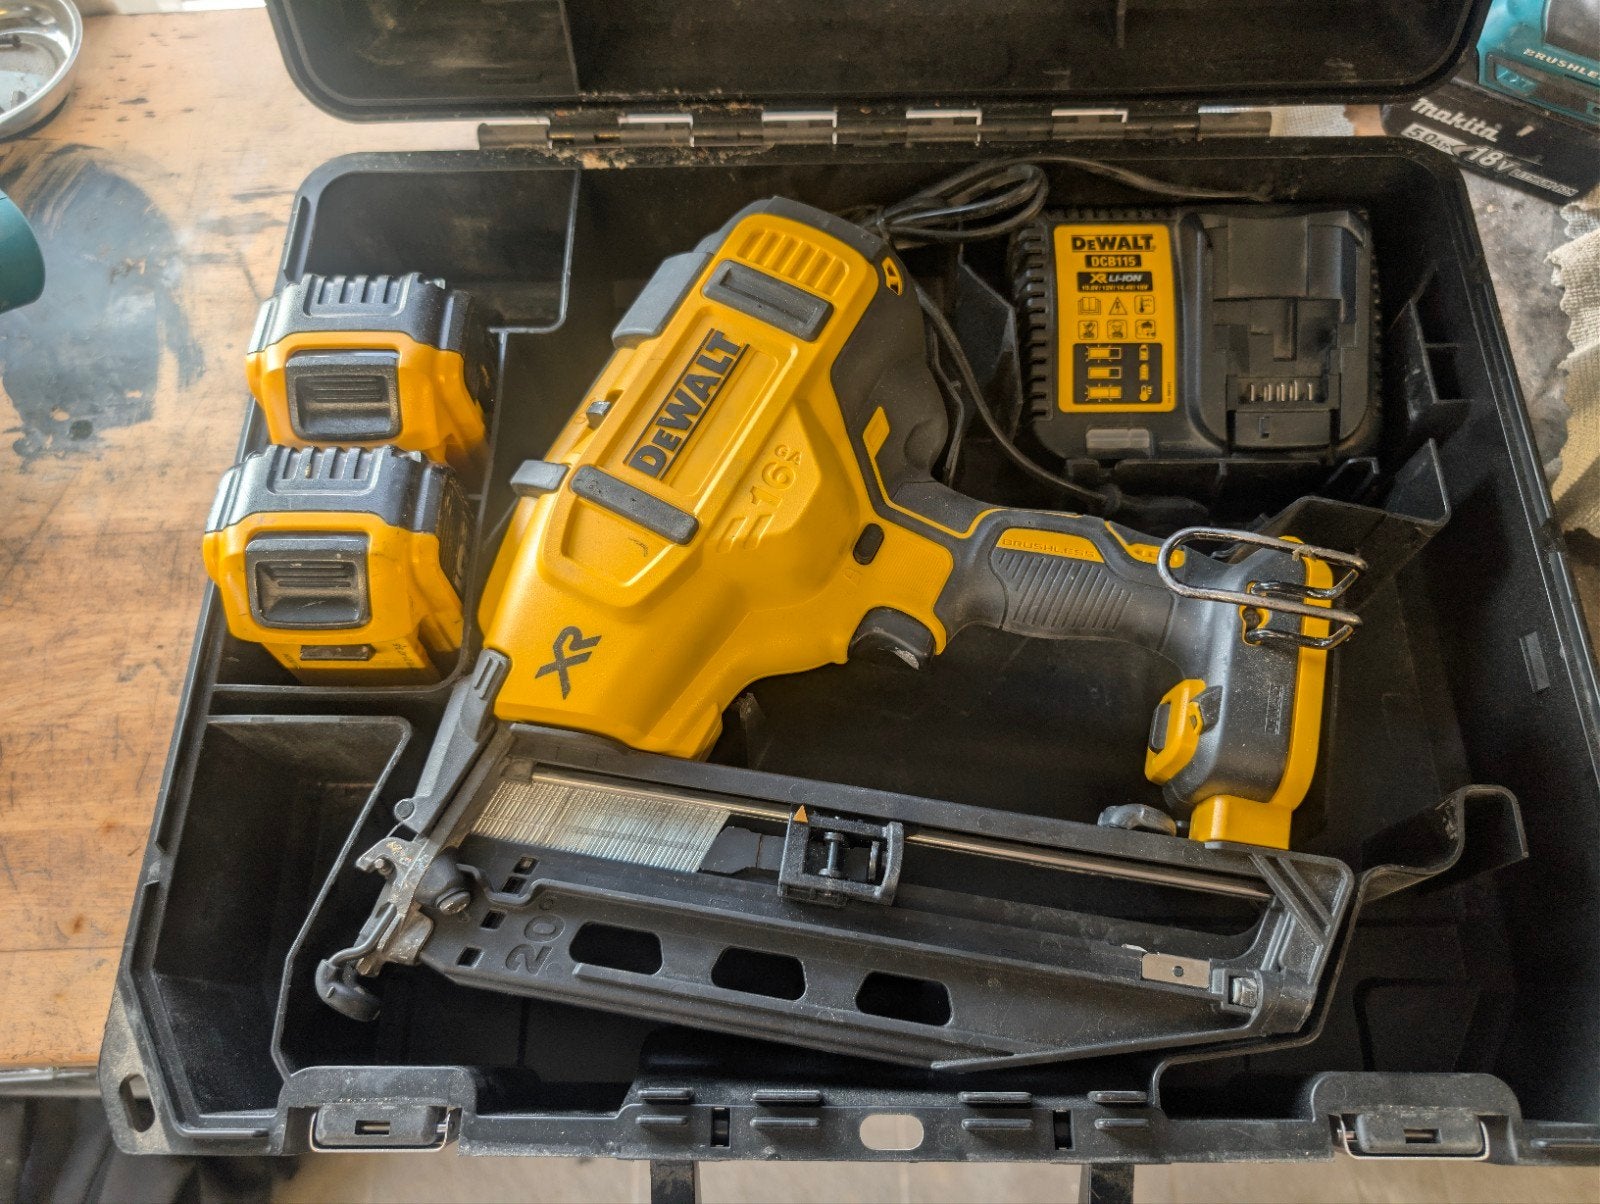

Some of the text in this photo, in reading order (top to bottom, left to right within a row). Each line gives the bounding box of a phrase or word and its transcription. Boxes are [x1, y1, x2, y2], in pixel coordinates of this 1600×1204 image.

[1523, 48, 1600, 79] BRUSHLE
[1091, 256, 1136, 267] DCB115
[1090, 273, 1107, 283] XR
[750, 461, 797, 508] 16
[1002, 537, 1095, 559] BRUSHLESS
